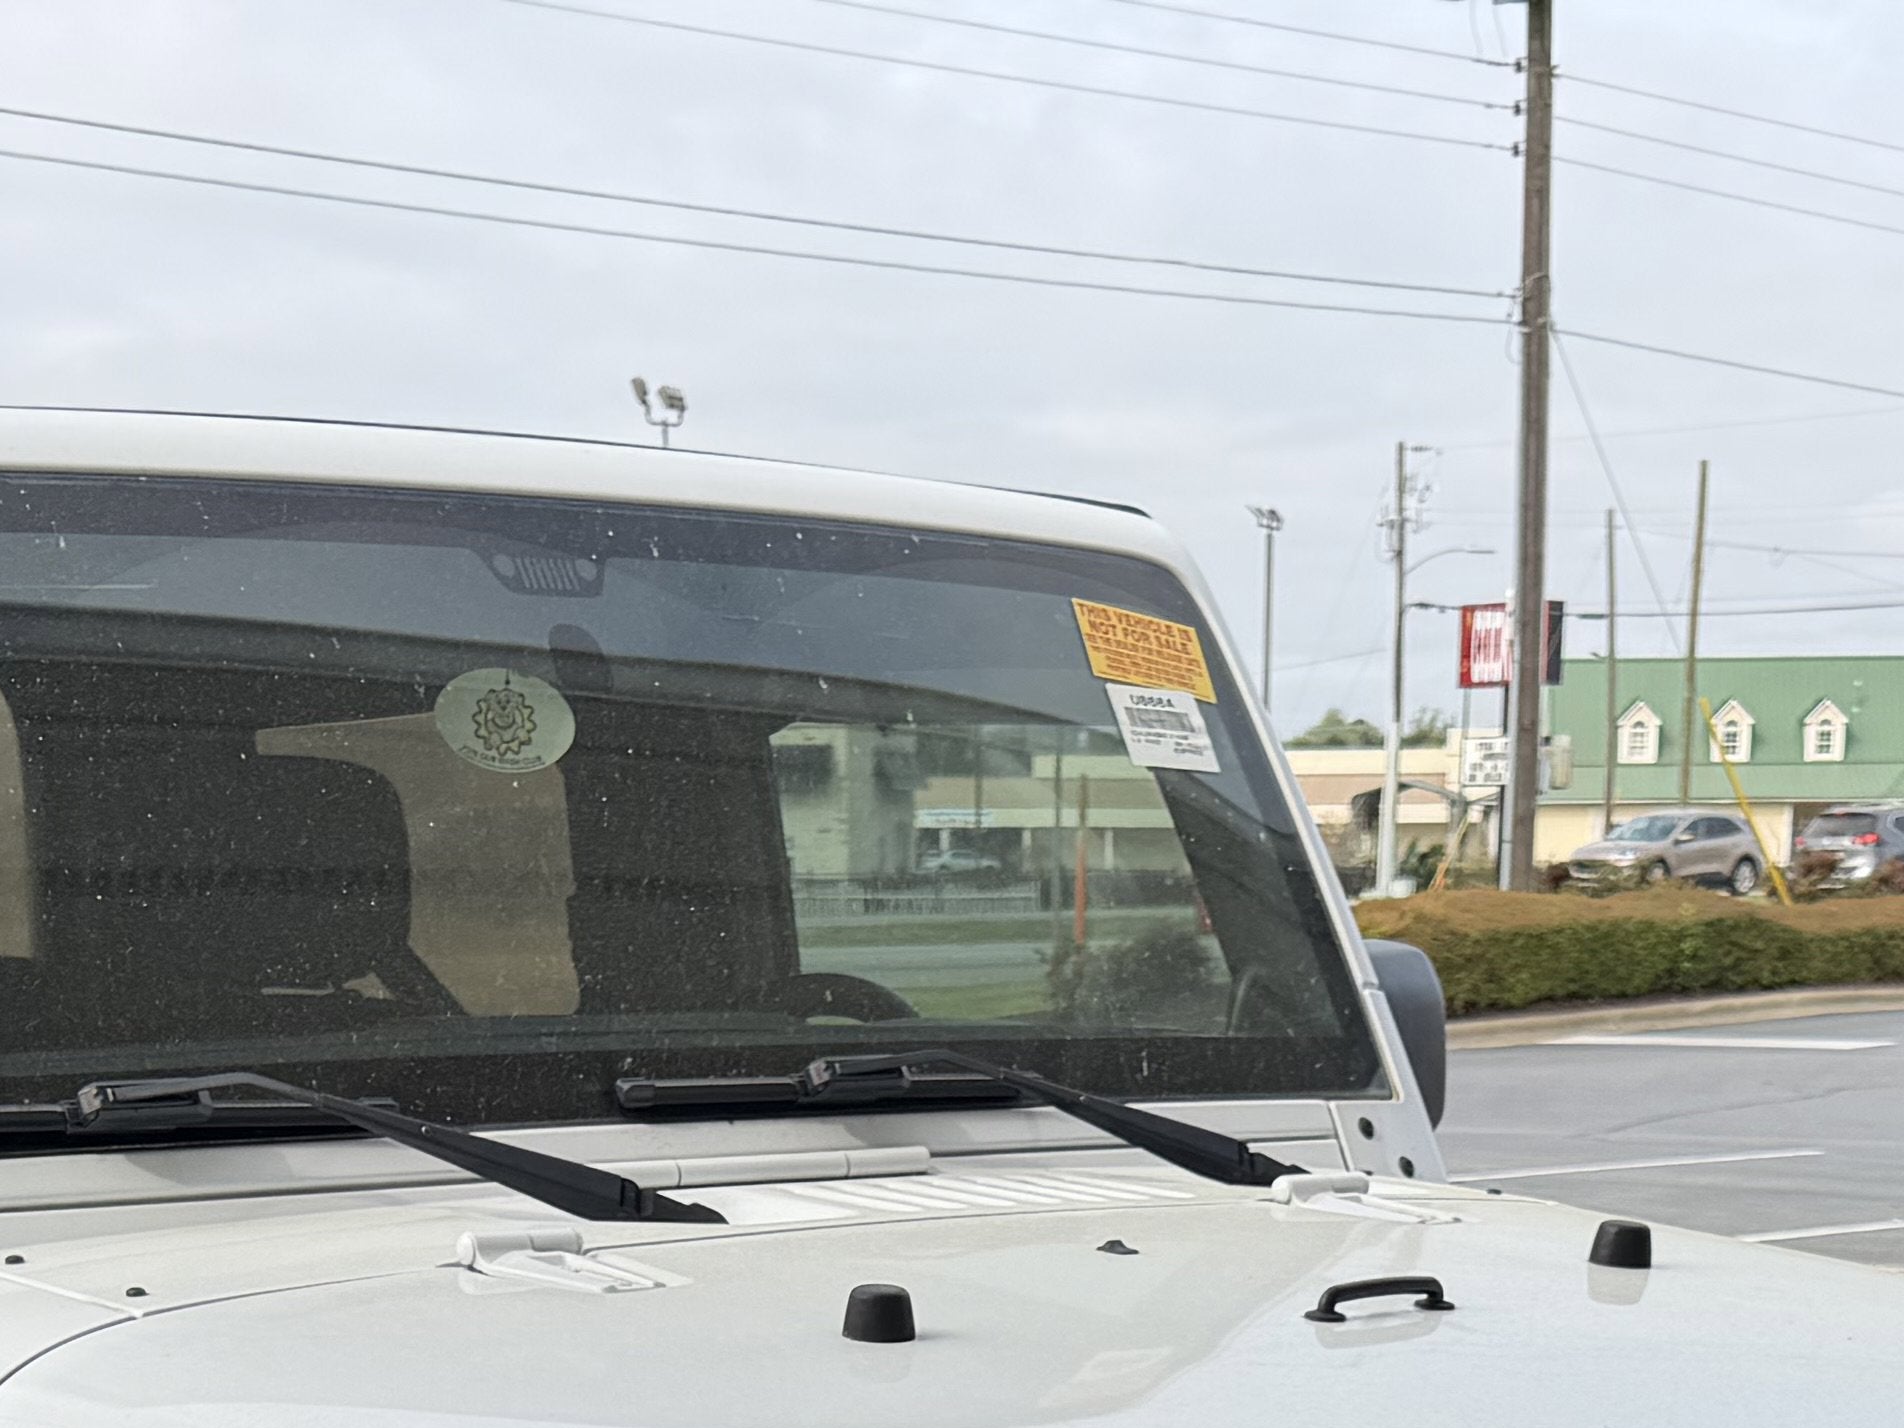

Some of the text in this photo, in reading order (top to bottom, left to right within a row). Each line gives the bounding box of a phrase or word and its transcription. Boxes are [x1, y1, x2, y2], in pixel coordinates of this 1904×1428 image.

[1077, 602, 1111, 621] THIS
[1114, 610, 1176, 638] VEHICLE
[1088, 619, 1117, 637] NOT
[1121, 626, 1152, 646] FOR
[1154, 635, 1193, 656] SALE
